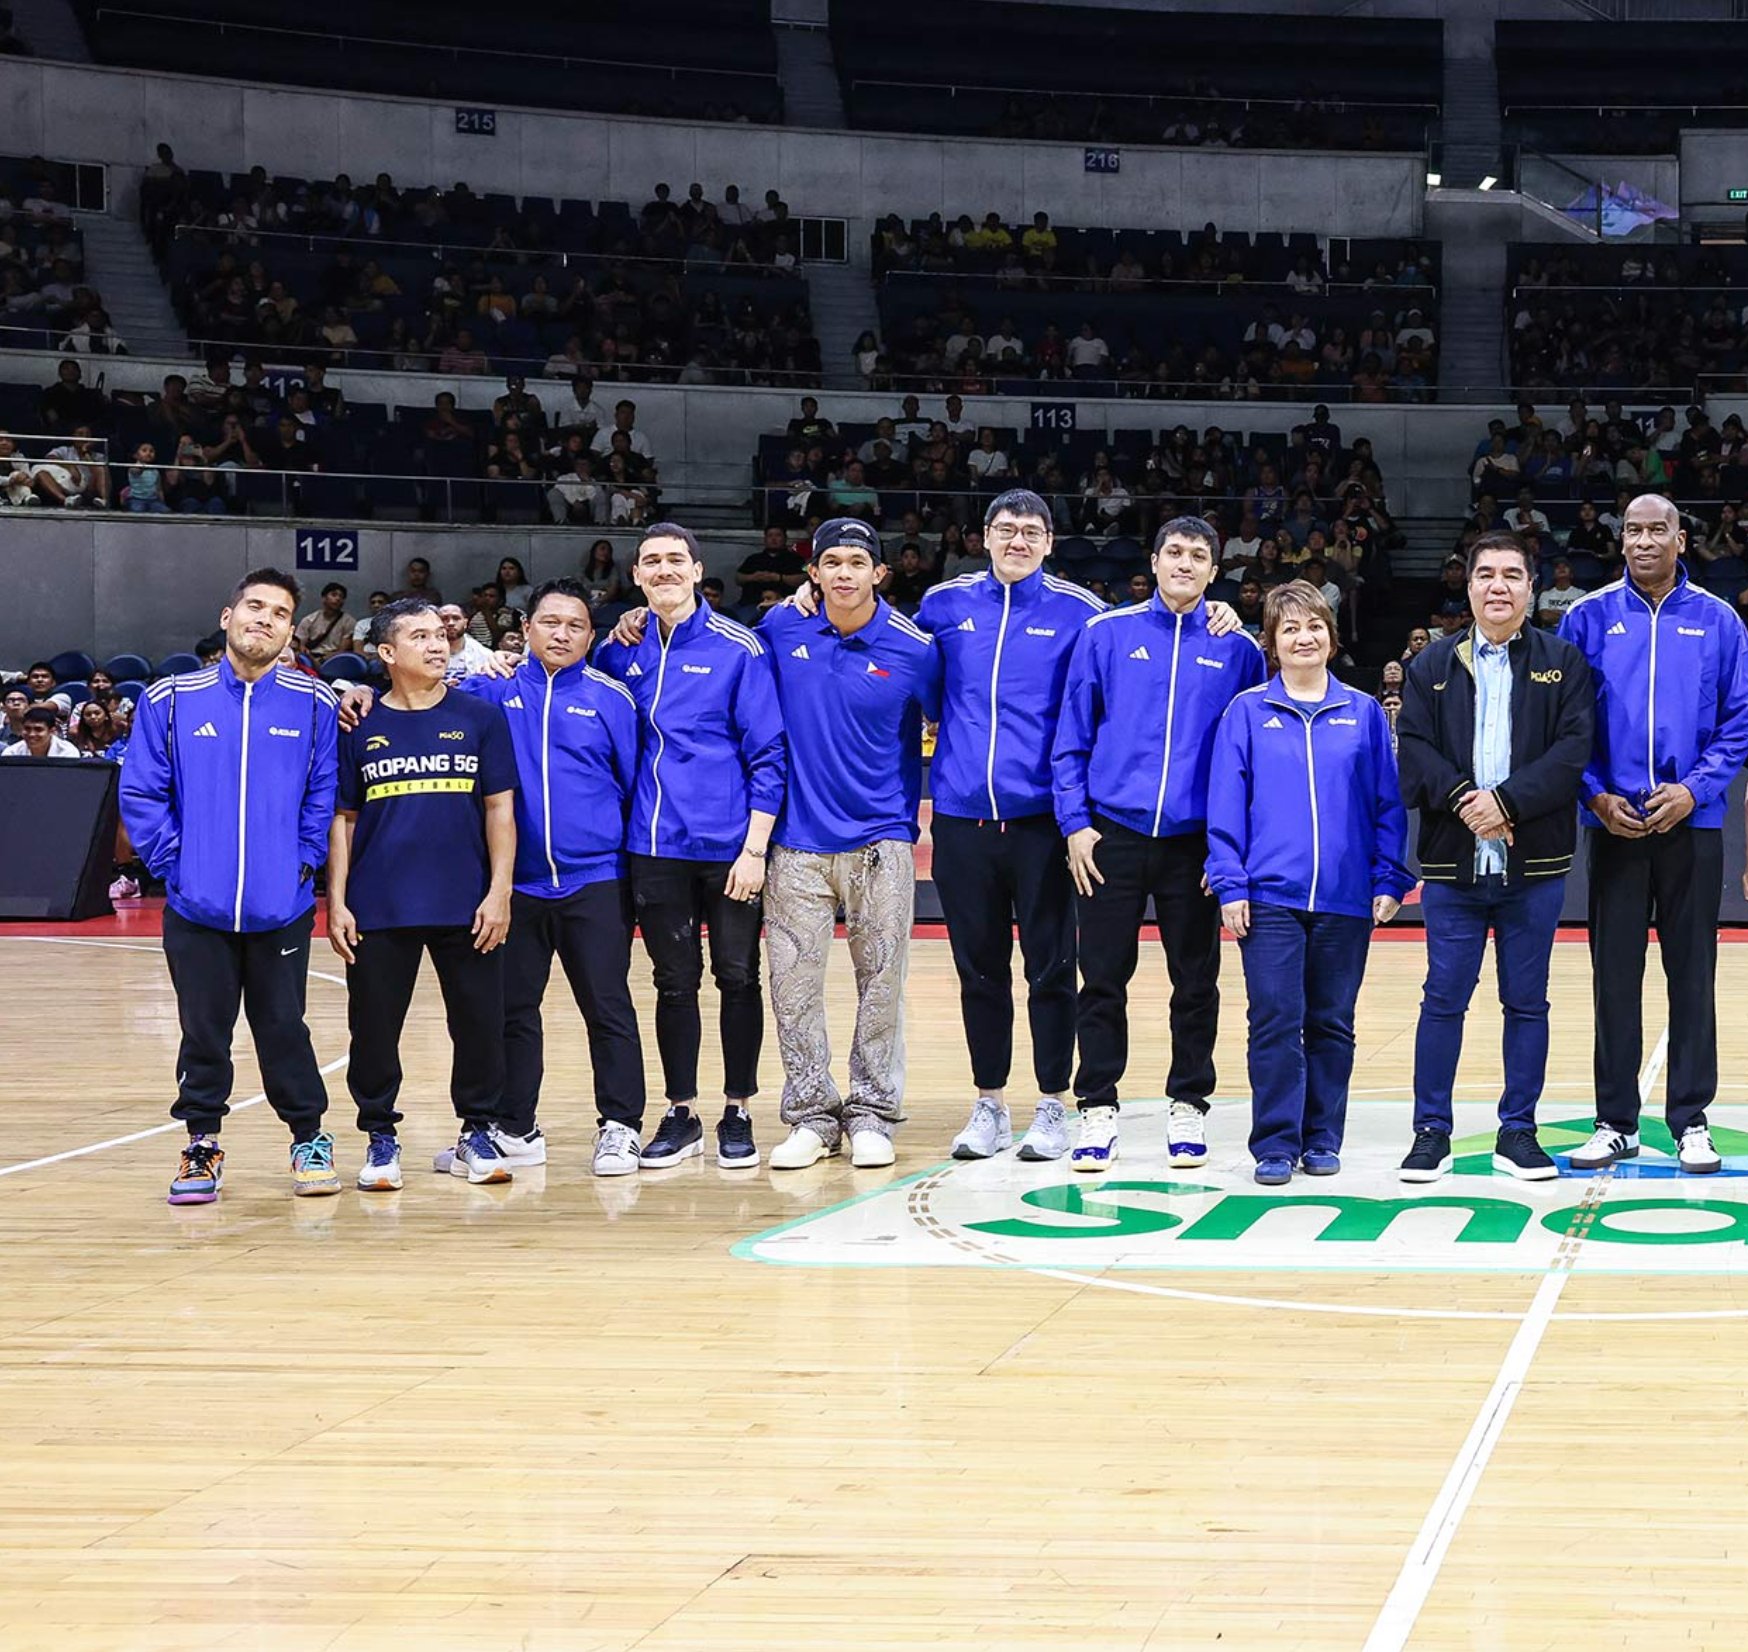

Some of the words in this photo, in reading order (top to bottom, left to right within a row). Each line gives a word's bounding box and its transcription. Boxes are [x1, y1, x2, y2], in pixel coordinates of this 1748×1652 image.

[458, 113, 494, 130] 215
[1085, 152, 1118, 168] 216
[1730, 190, 1748, 199] EXIT
[1033, 408, 1073, 428] 113
[300, 537, 354, 563] 112
[361, 754, 450, 782] TROPANG
[454, 754, 479, 773] 5G
[368, 780, 470, 797] ASKETBALL
